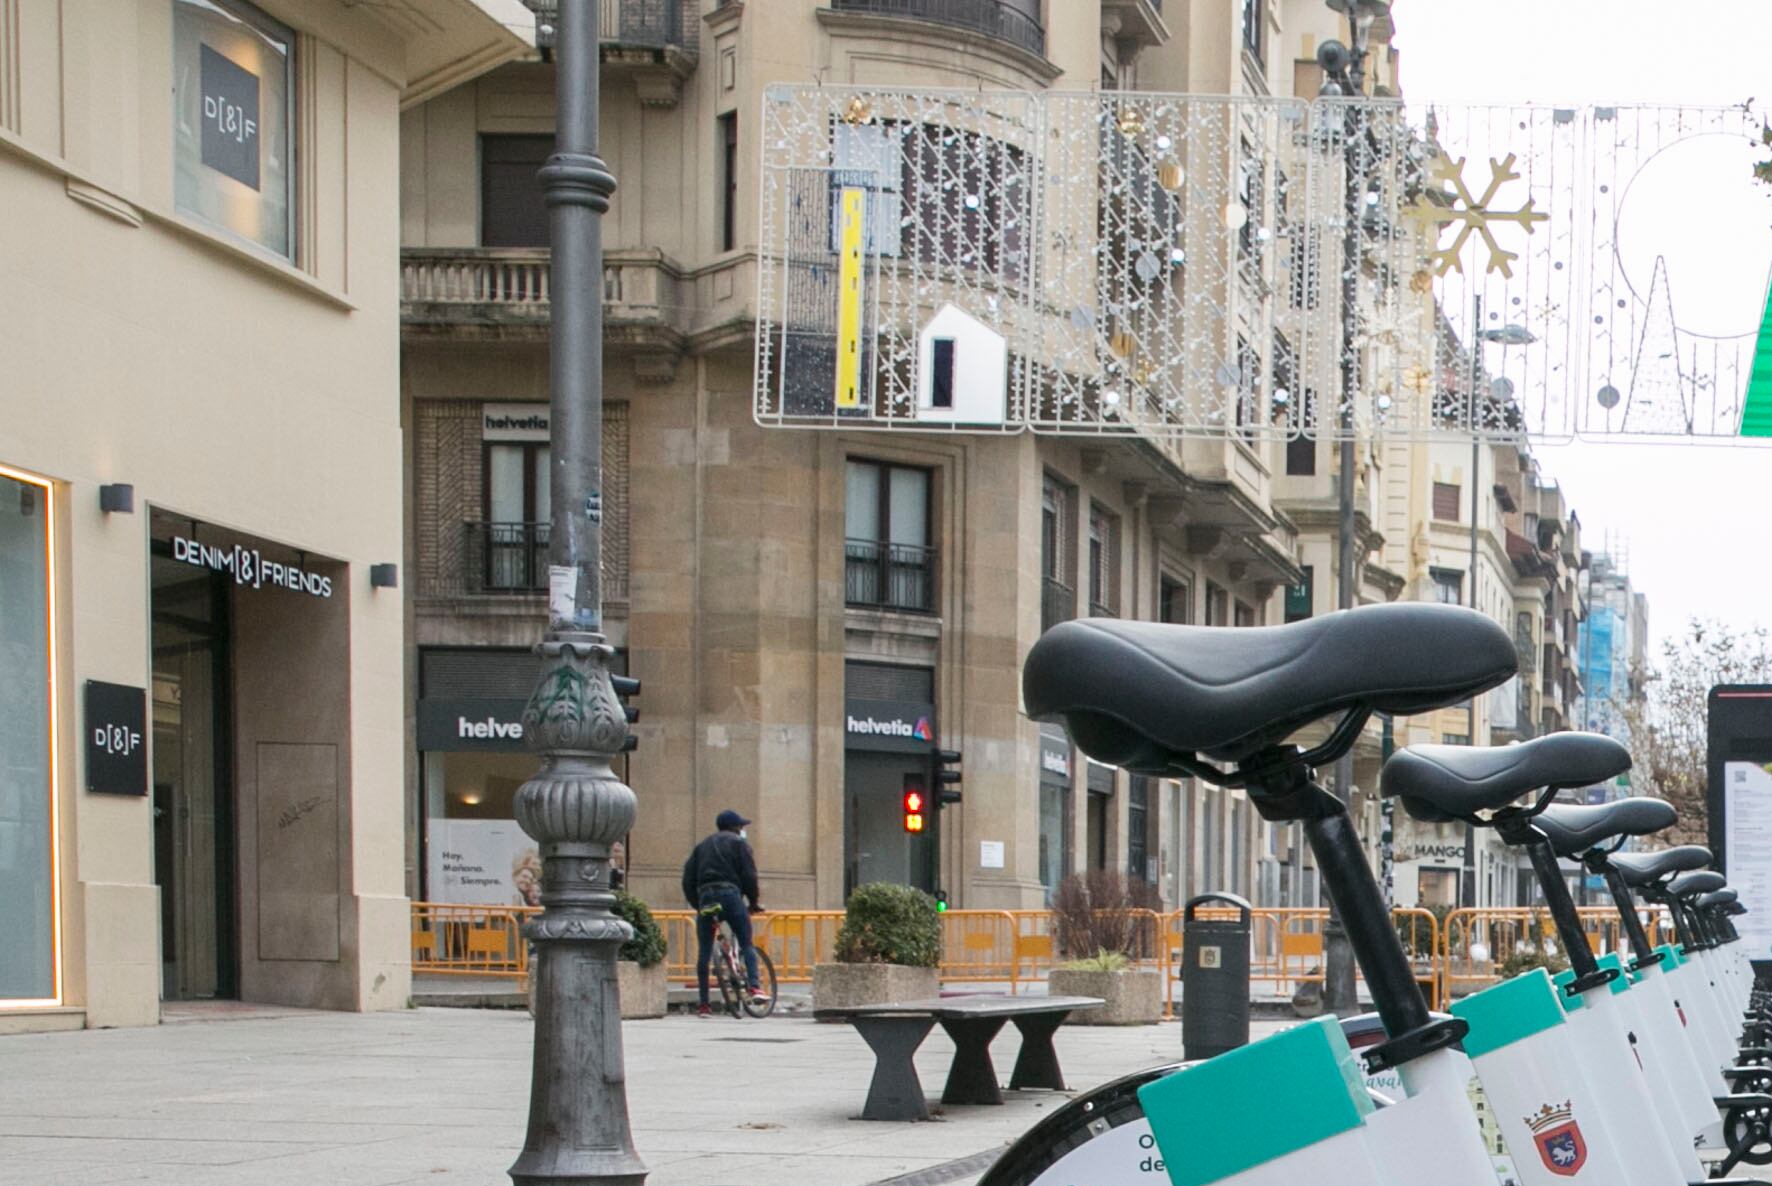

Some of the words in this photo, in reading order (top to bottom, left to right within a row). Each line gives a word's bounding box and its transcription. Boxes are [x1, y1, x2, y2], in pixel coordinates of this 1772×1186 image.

[485, 414, 549, 430] helvetia
[458, 716, 524, 739] helve
[848, 715, 913, 737] helvetia
[1415, 844, 1466, 858] MANGO
